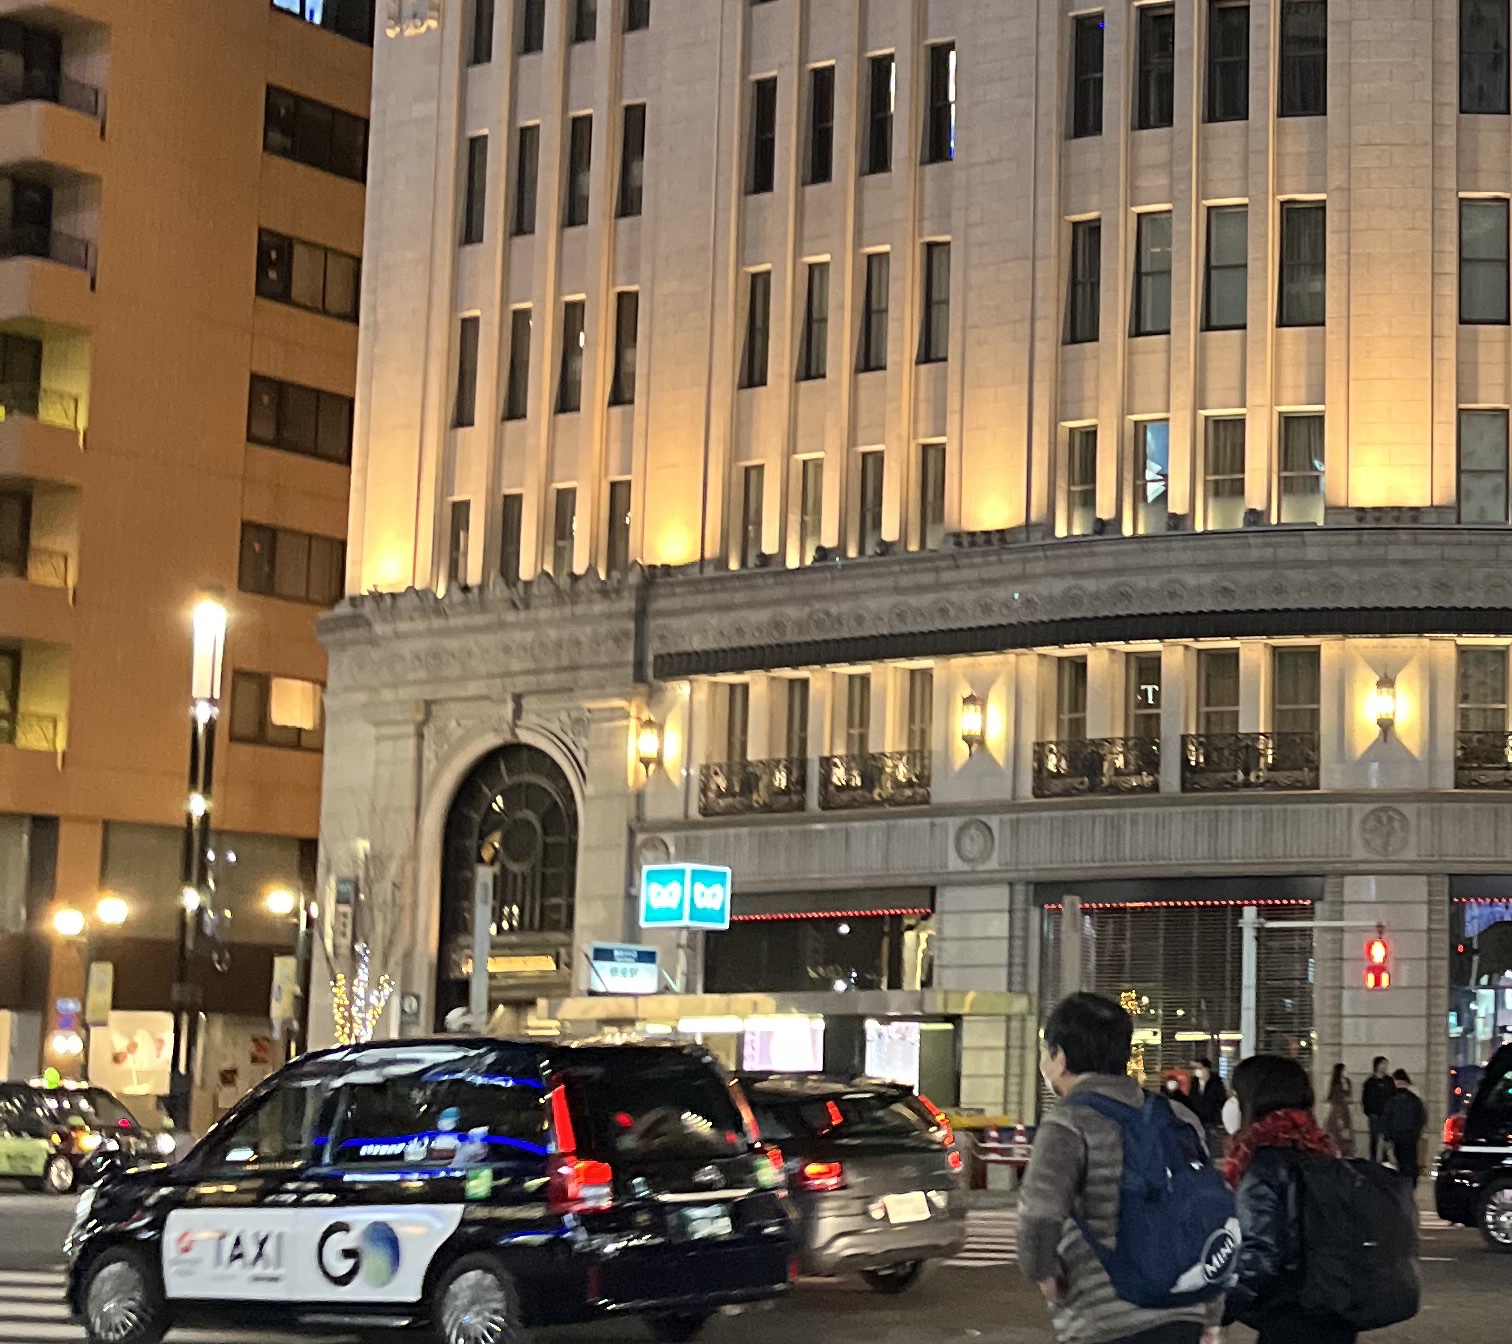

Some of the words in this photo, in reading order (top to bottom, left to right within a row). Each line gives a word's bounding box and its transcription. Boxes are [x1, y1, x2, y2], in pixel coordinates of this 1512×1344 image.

[213, 1230, 285, 1270] TAXI
[316, 1220, 400, 1288] GO
[1205, 1235, 1234, 1278] MINI
